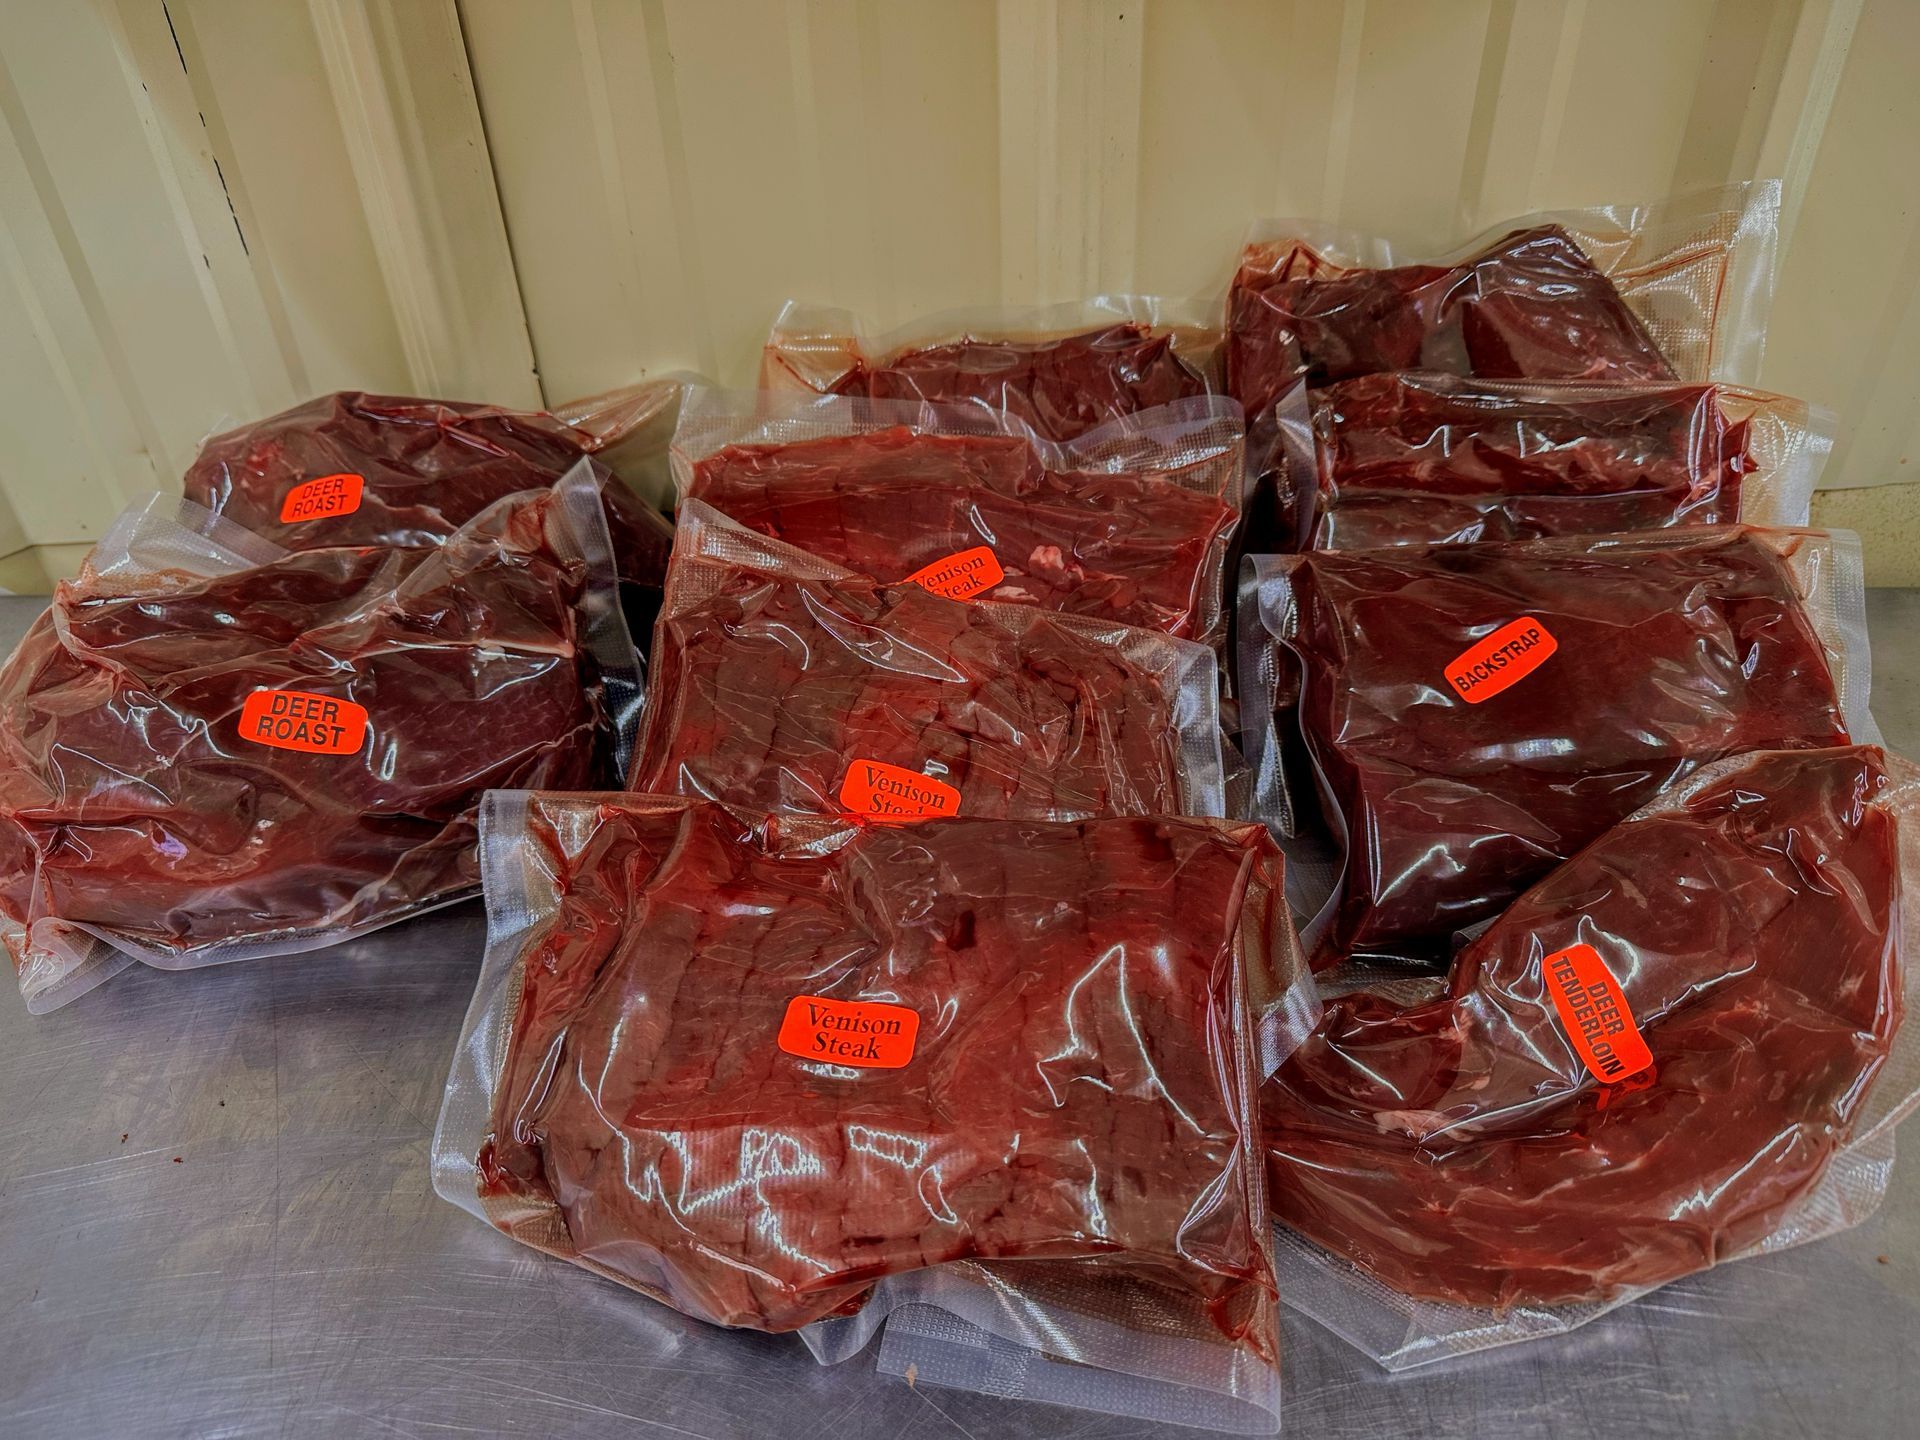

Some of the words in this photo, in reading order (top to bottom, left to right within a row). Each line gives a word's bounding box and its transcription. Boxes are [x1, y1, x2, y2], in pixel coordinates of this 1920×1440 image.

[302, 479, 344, 499] DEER
[292, 494, 348, 518] ROAST
[1454, 628, 1540, 692] BACKSTRAP
[272, 694, 339, 723] DEER
[256, 715, 346, 747] ROAST
[866, 765, 945, 809] Venison
[808, 1003, 901, 1035] Venison
[1551, 955, 1626, 1077] TENDERLOIN
[1587, 981, 1625, 1036] DEER
[812, 1031, 882, 1059] Steak
